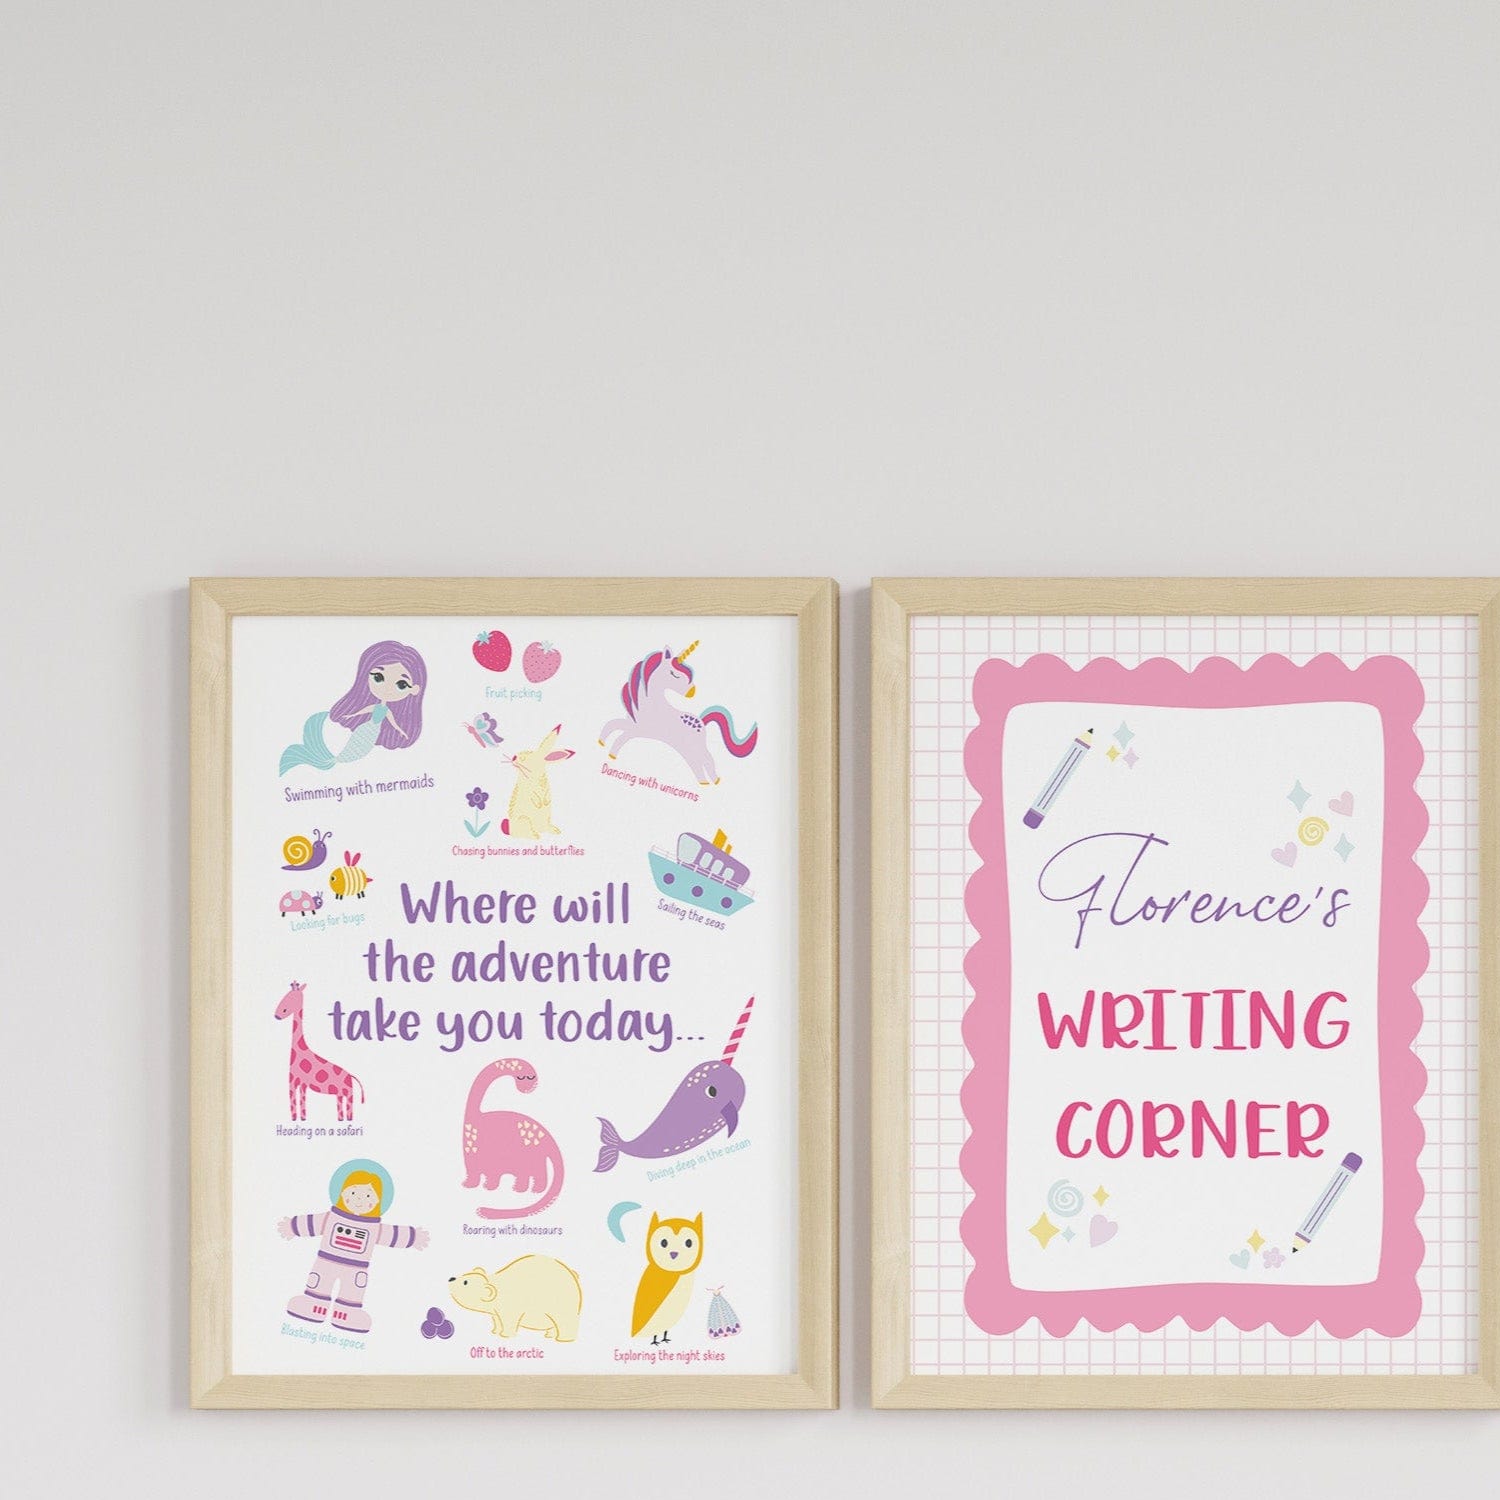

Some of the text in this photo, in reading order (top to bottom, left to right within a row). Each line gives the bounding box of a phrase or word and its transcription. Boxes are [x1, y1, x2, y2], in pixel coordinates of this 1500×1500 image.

[484, 686, 543, 702] Fruit picking
[284, 773, 435, 803] Swimming with mermaids
[601, 762, 700, 802] Dancing with unicorns
[452, 844, 585, 860] Chasing bunnies and butterflies
[400, 880, 630, 924] Where will
[1037, 831, 1351, 950] Florence's
[290, 912, 366, 932] Looking for bugs
[657, 898, 727, 931] Sailing the seas
[363, 939, 671, 983] the adventure
[327, 997, 706, 1053] take you today...
[1037, 989, 1351, 1052] WRITING
[276, 1124, 363, 1140] Heading on a safari
[1054, 1097, 1331, 1160] CORNER
[646, 1138, 753, 1182] Diving deep in the ocean
[462, 1223, 563, 1239] Roaring with dinosaurs
[281, 1322, 367, 1350] Blasting into space
[470, 1346, 545, 1359] Off to the arctic
[613, 1349, 726, 1365] Exploring the night skies
